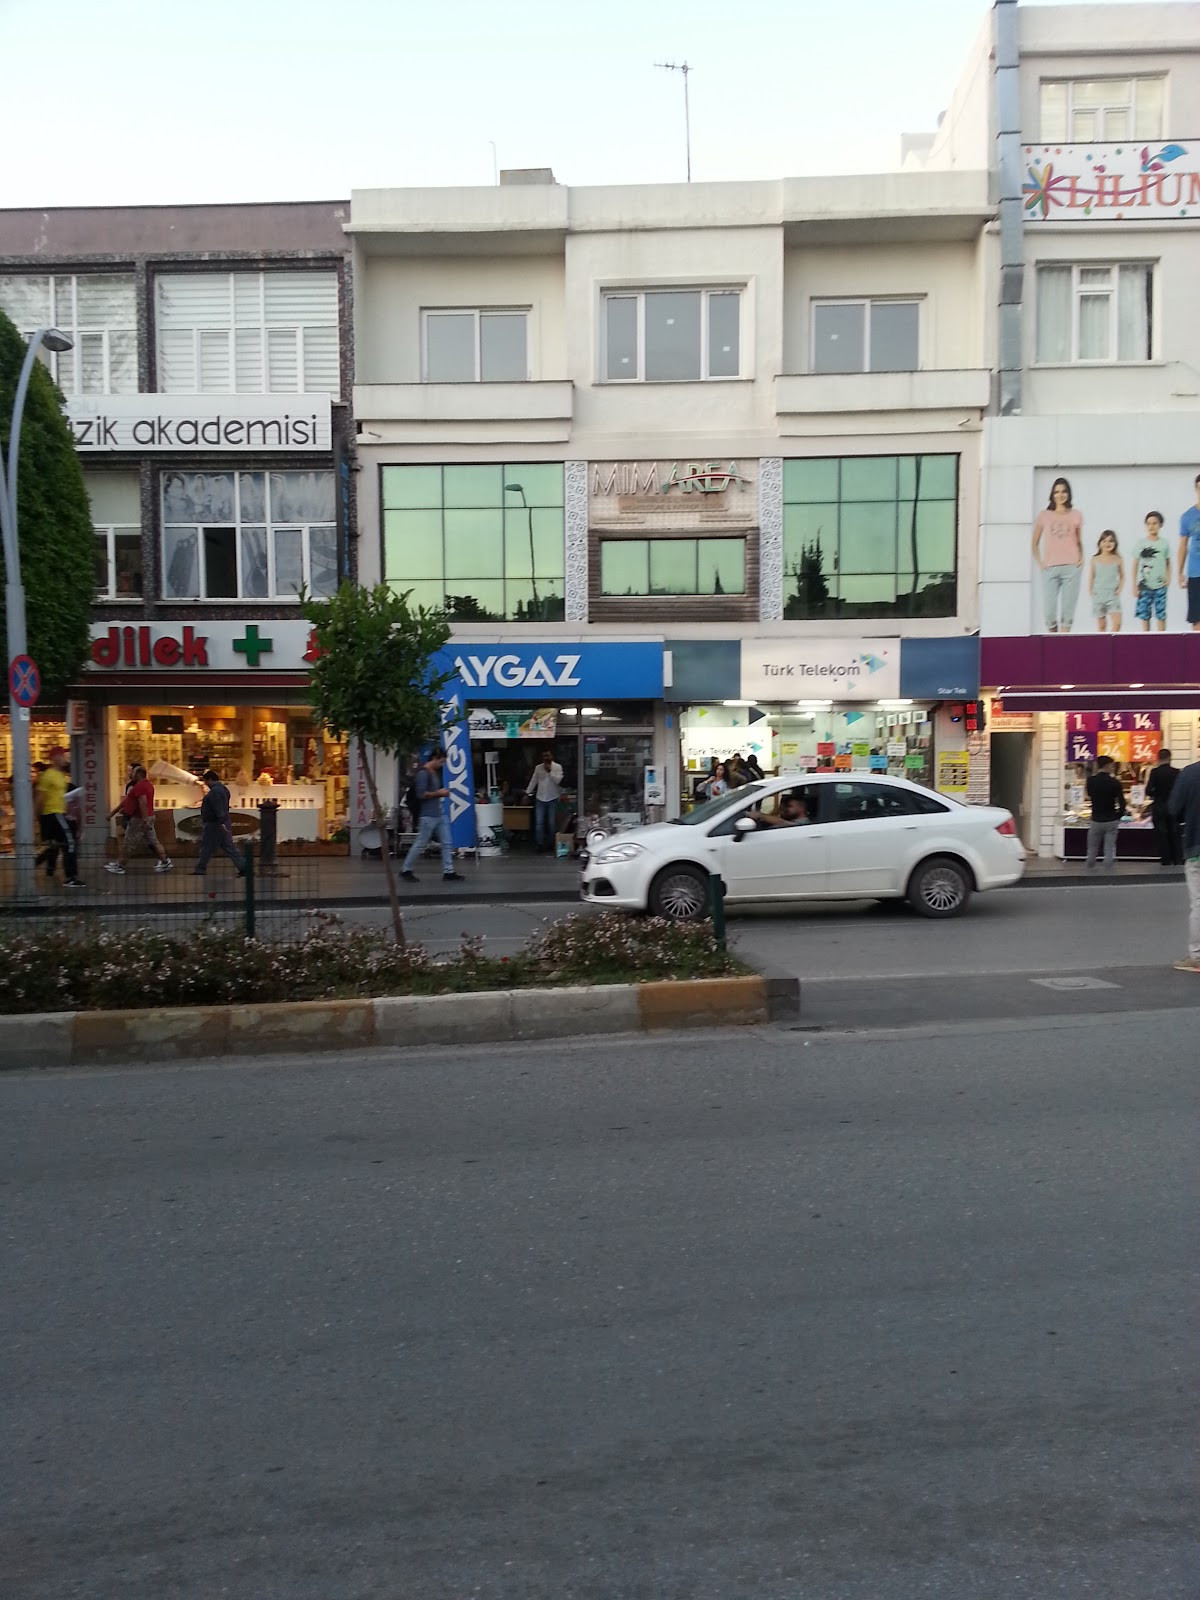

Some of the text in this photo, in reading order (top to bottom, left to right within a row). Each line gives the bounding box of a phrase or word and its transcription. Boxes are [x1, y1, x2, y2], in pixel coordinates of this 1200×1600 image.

[133, 414, 318, 446] akademisi
[91, 626, 209, 666] dilek
[454, 654, 582, 688] AYGAZ
[763, 663, 861, 677] Türk Telekom
[84, 738, 97, 825] APOTHEKE
